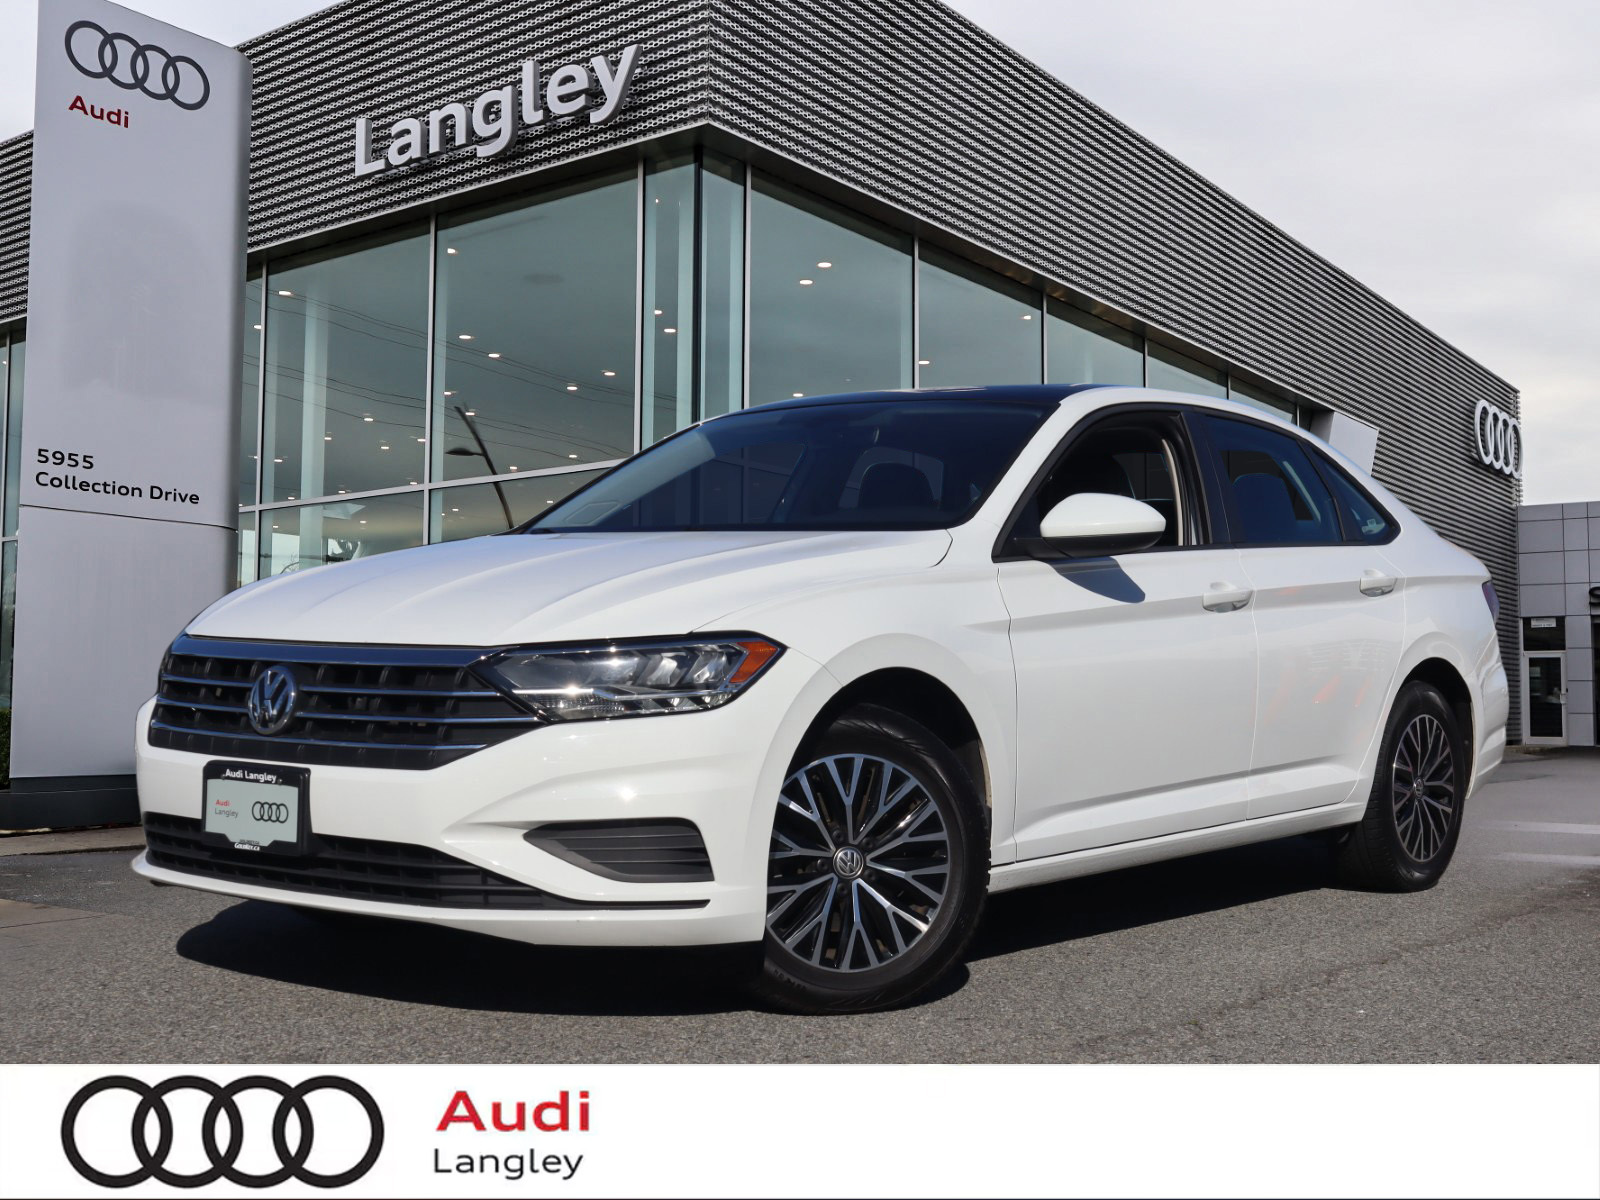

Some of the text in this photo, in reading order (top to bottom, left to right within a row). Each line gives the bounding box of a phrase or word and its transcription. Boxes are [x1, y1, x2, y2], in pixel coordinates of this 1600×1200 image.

[68, 95, 129, 129] Audi
[354, 43, 644, 178] Langley
[37, 448, 95, 470] 5955
[35, 471, 200, 505] Collection Drive
[225, 768, 277, 784] Audi Langley
[214, 807, 239, 819] Langley
[215, 799, 230, 807] Audi
